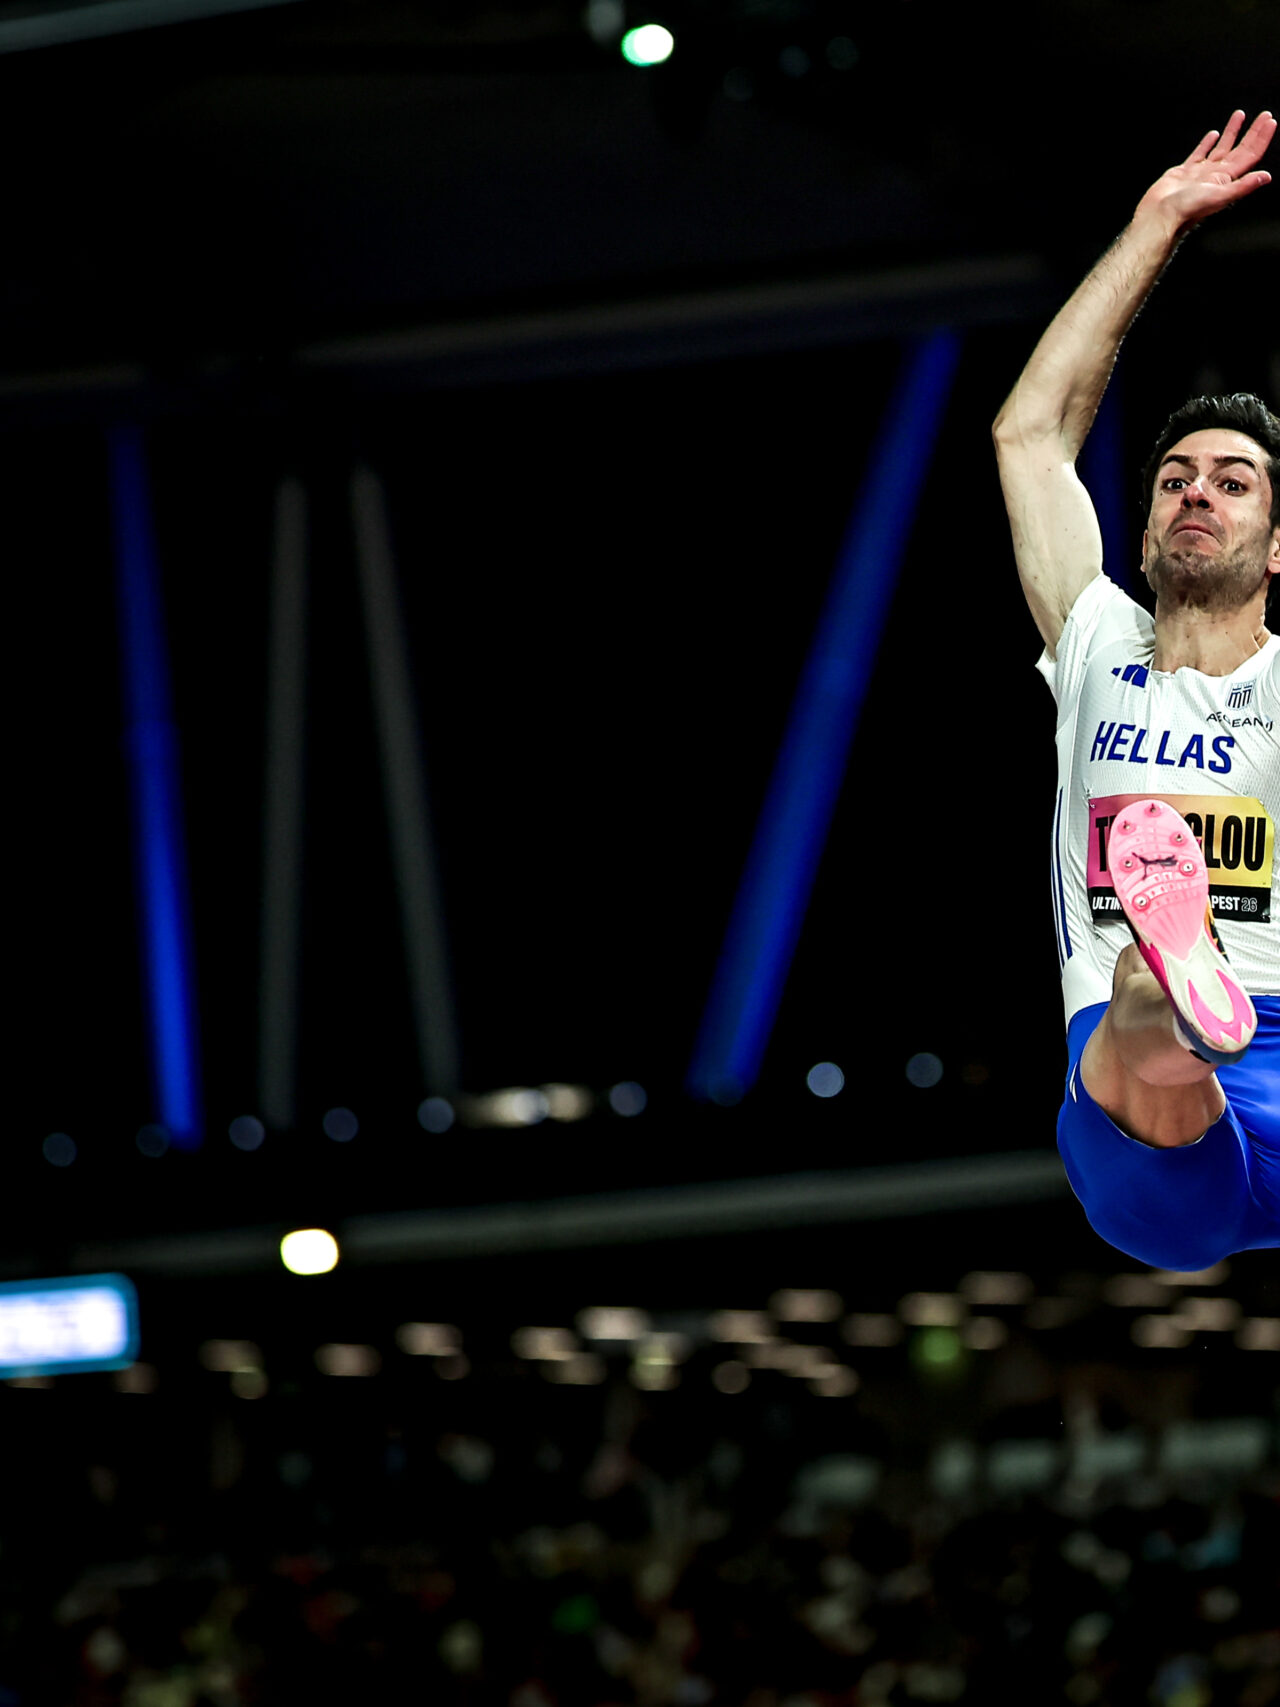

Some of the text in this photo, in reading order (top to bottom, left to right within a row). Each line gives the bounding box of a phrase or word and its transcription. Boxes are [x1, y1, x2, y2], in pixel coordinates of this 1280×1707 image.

[1090, 720, 1235, 774] HELLAS
[1211, 895, 1240, 911] PEST
[1241, 897, 1258, 913] 26
